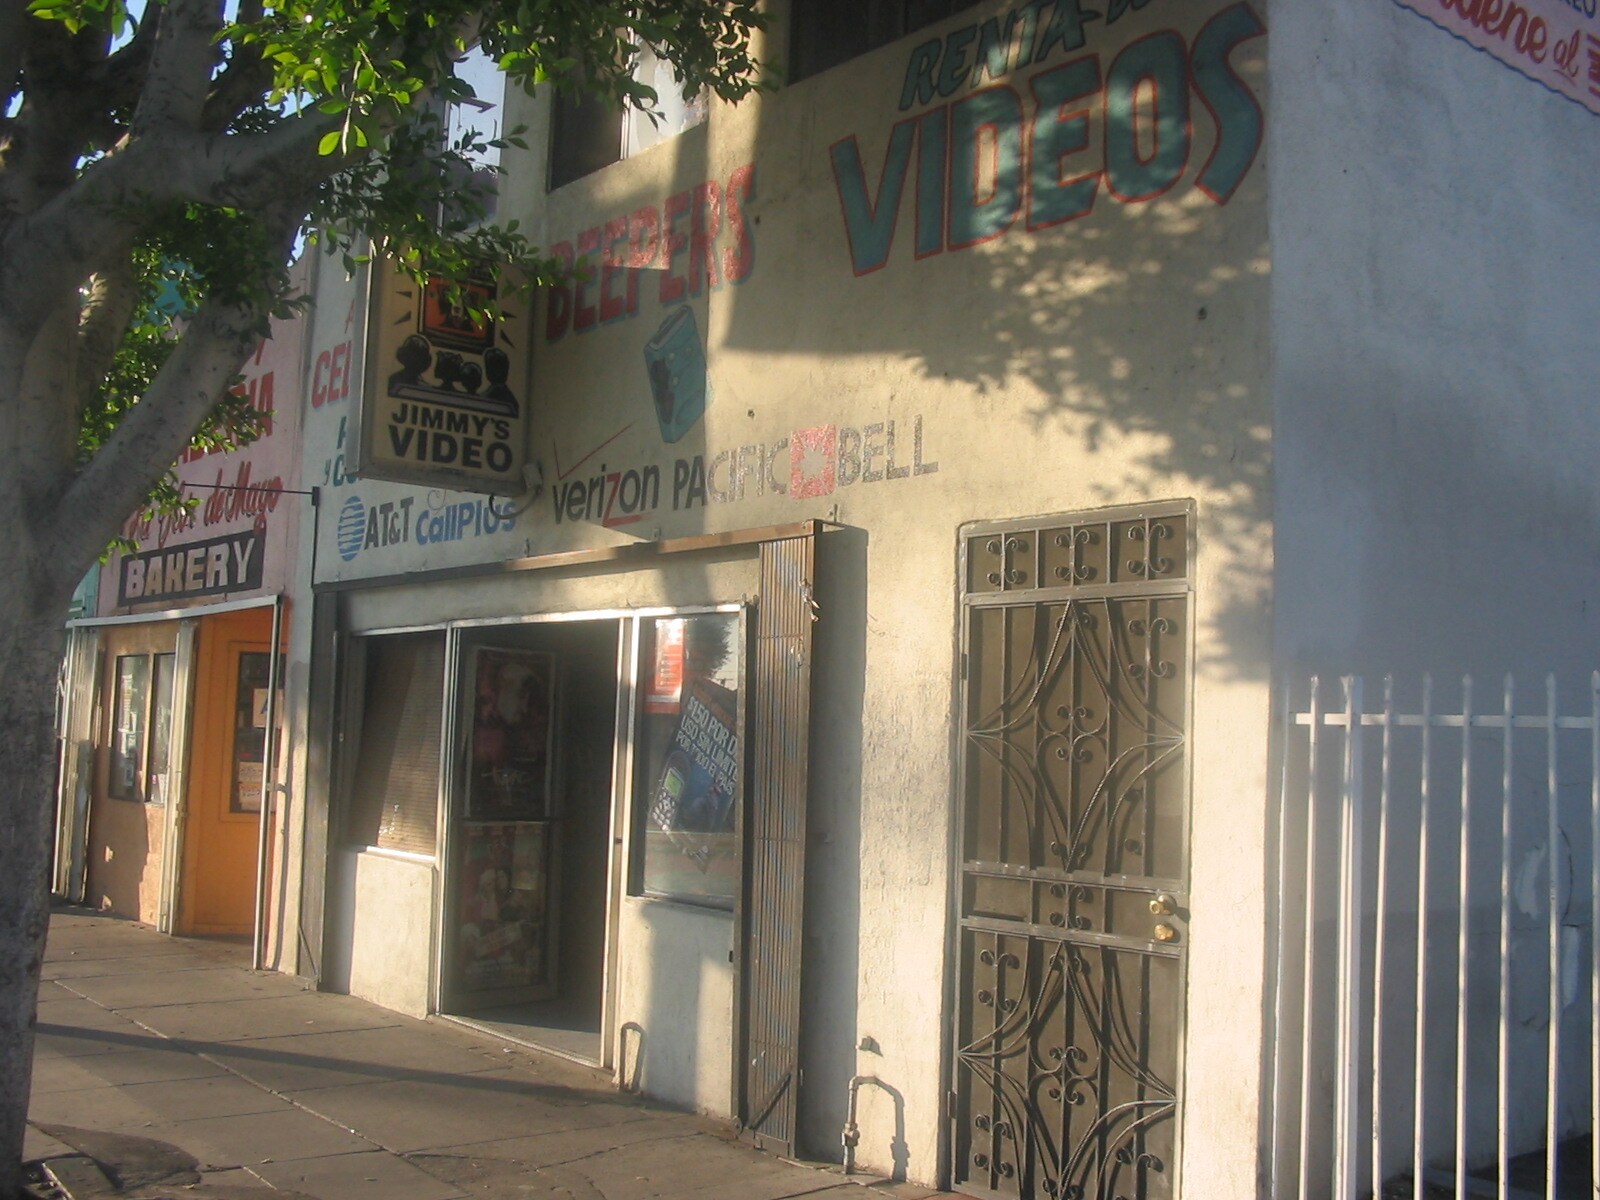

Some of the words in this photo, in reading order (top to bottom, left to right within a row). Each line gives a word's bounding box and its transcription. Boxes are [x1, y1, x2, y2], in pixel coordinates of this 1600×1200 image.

[829, 1, 1268, 277] VIDEOS
[546, 162, 757, 342] BEEPERS
[388, 424, 513, 473] VIDEO
[391, 403, 510, 441] JIMMY'S
[673, 438, 789, 512] PACIFIC
[837, 413, 939, 488] BELL
[363, 497, 414, 550] AT&T
[552, 464, 660, 527] verizon
[125, 538, 255, 600] BAKERY
